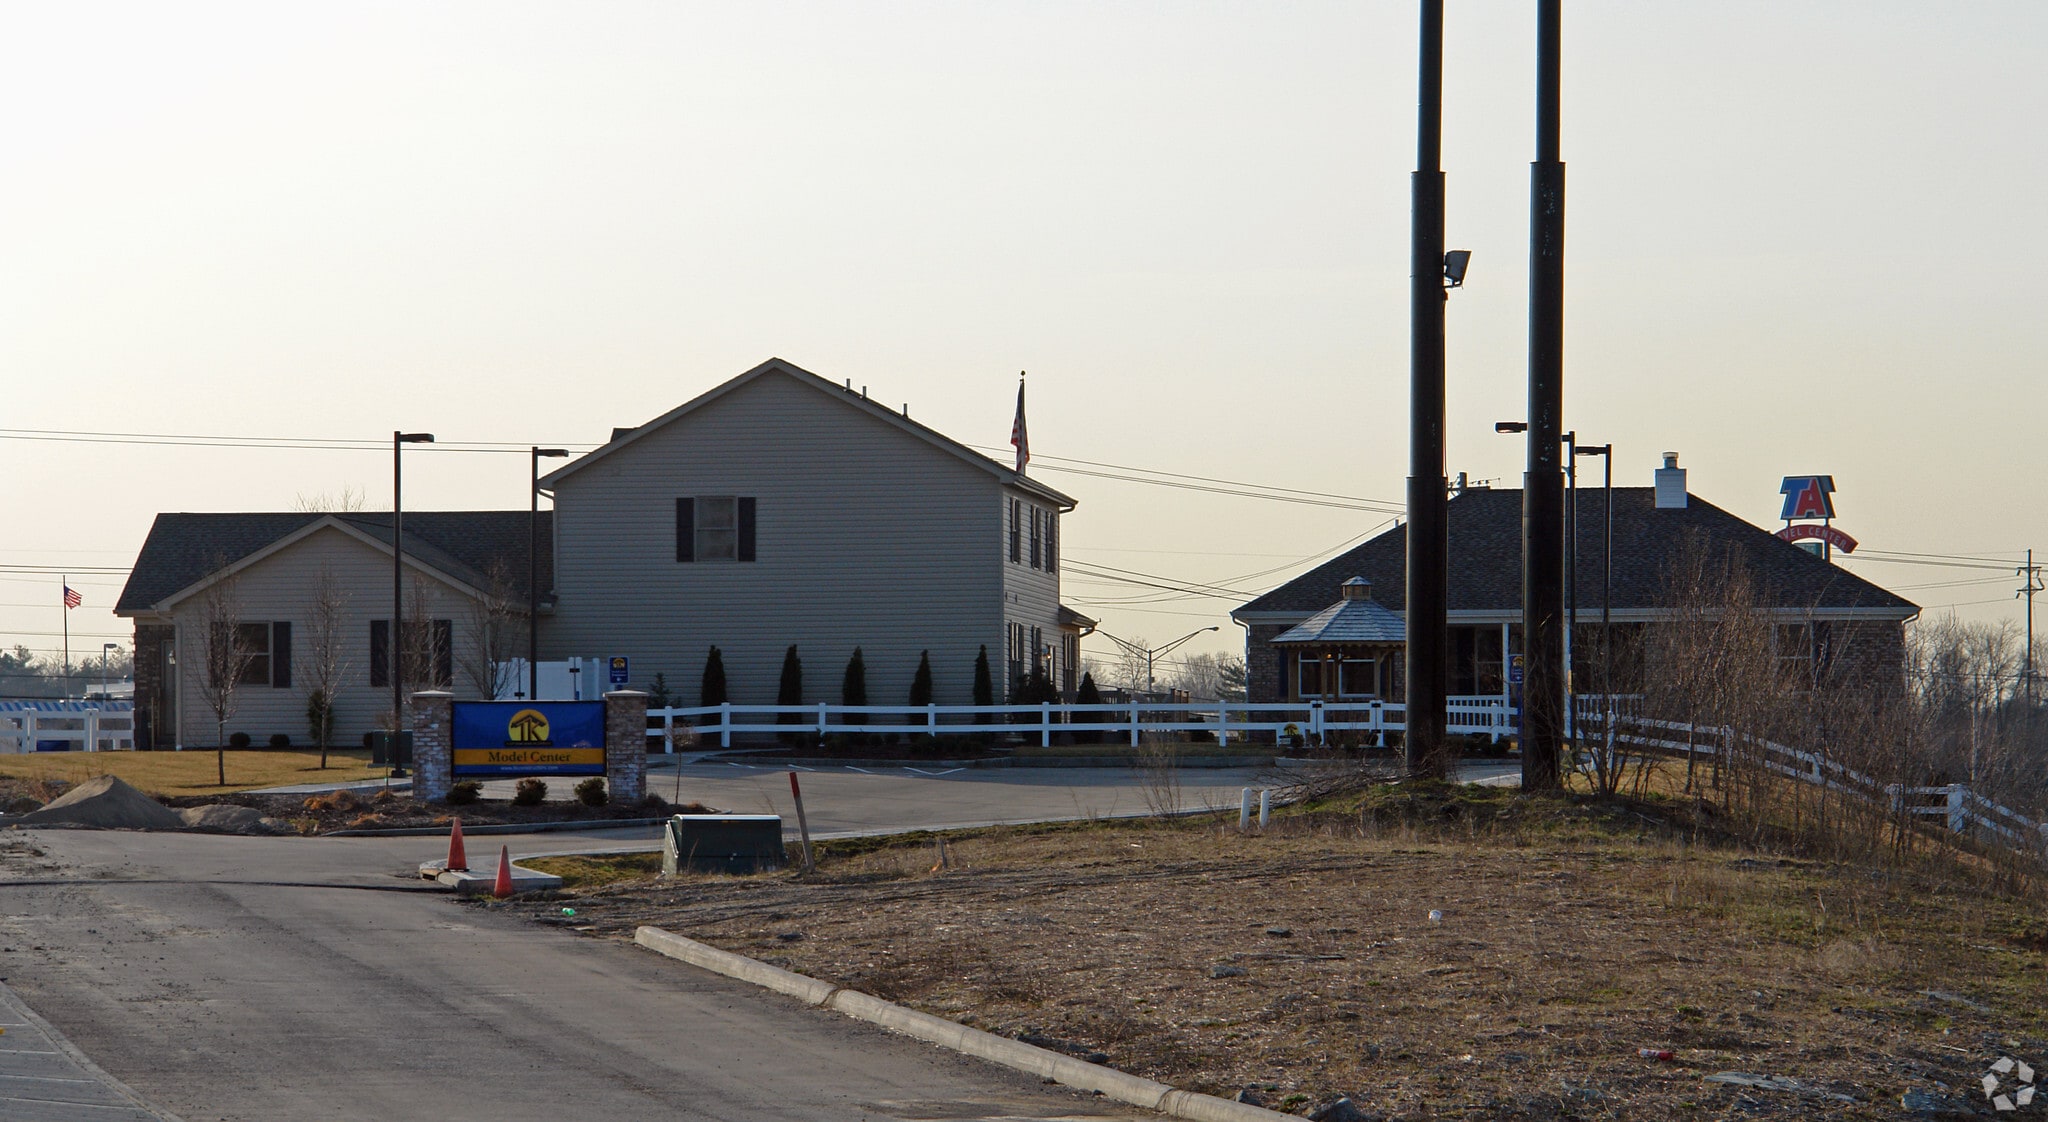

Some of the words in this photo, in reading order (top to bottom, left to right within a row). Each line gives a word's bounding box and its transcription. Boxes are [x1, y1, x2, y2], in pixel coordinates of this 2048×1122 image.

[1780, 476, 1831, 520] TA
[1808, 527, 1847, 549] CENTER
[488, 751, 527, 762] Model
[530, 751, 571, 762] Center
